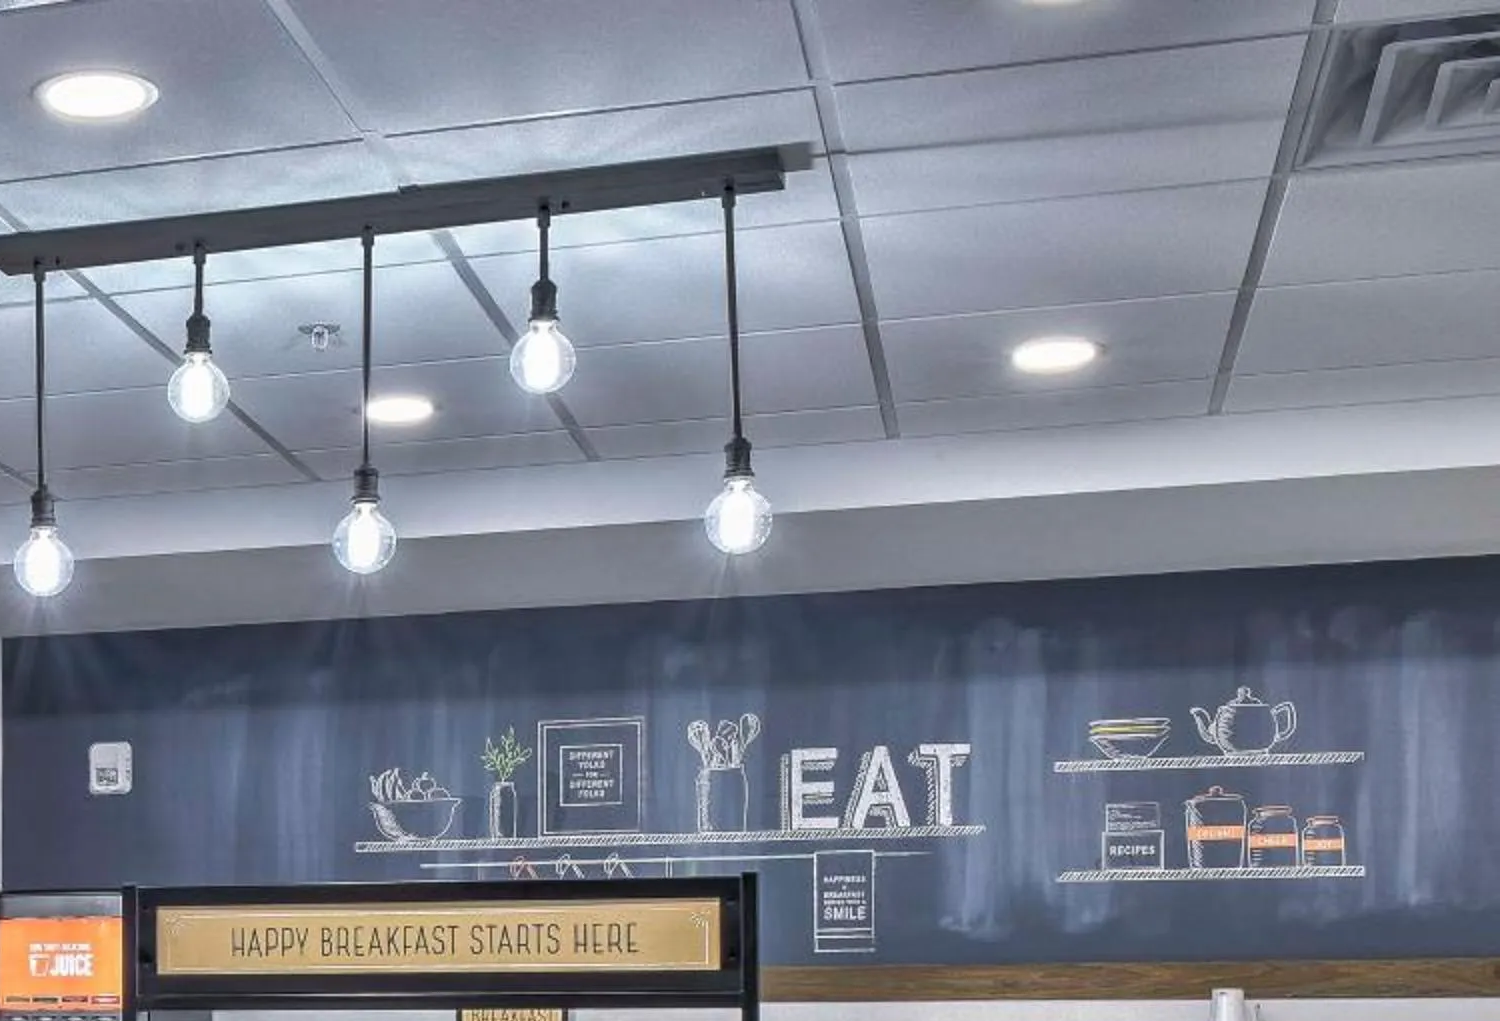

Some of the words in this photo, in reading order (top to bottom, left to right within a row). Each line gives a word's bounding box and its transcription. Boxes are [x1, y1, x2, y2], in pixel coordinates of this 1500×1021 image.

[781, 743, 971, 832] EAT
[1109, 845, 1156, 856] RECIPES
[823, 905, 866, 920] SMILE
[231, 927, 309, 958] HAPPY
[320, 925, 458, 957] BREAKFAST
[469, 923, 562, 956] STARTS
[573, 922, 641, 954] HERE
[50, 953, 94, 977] JUICE
